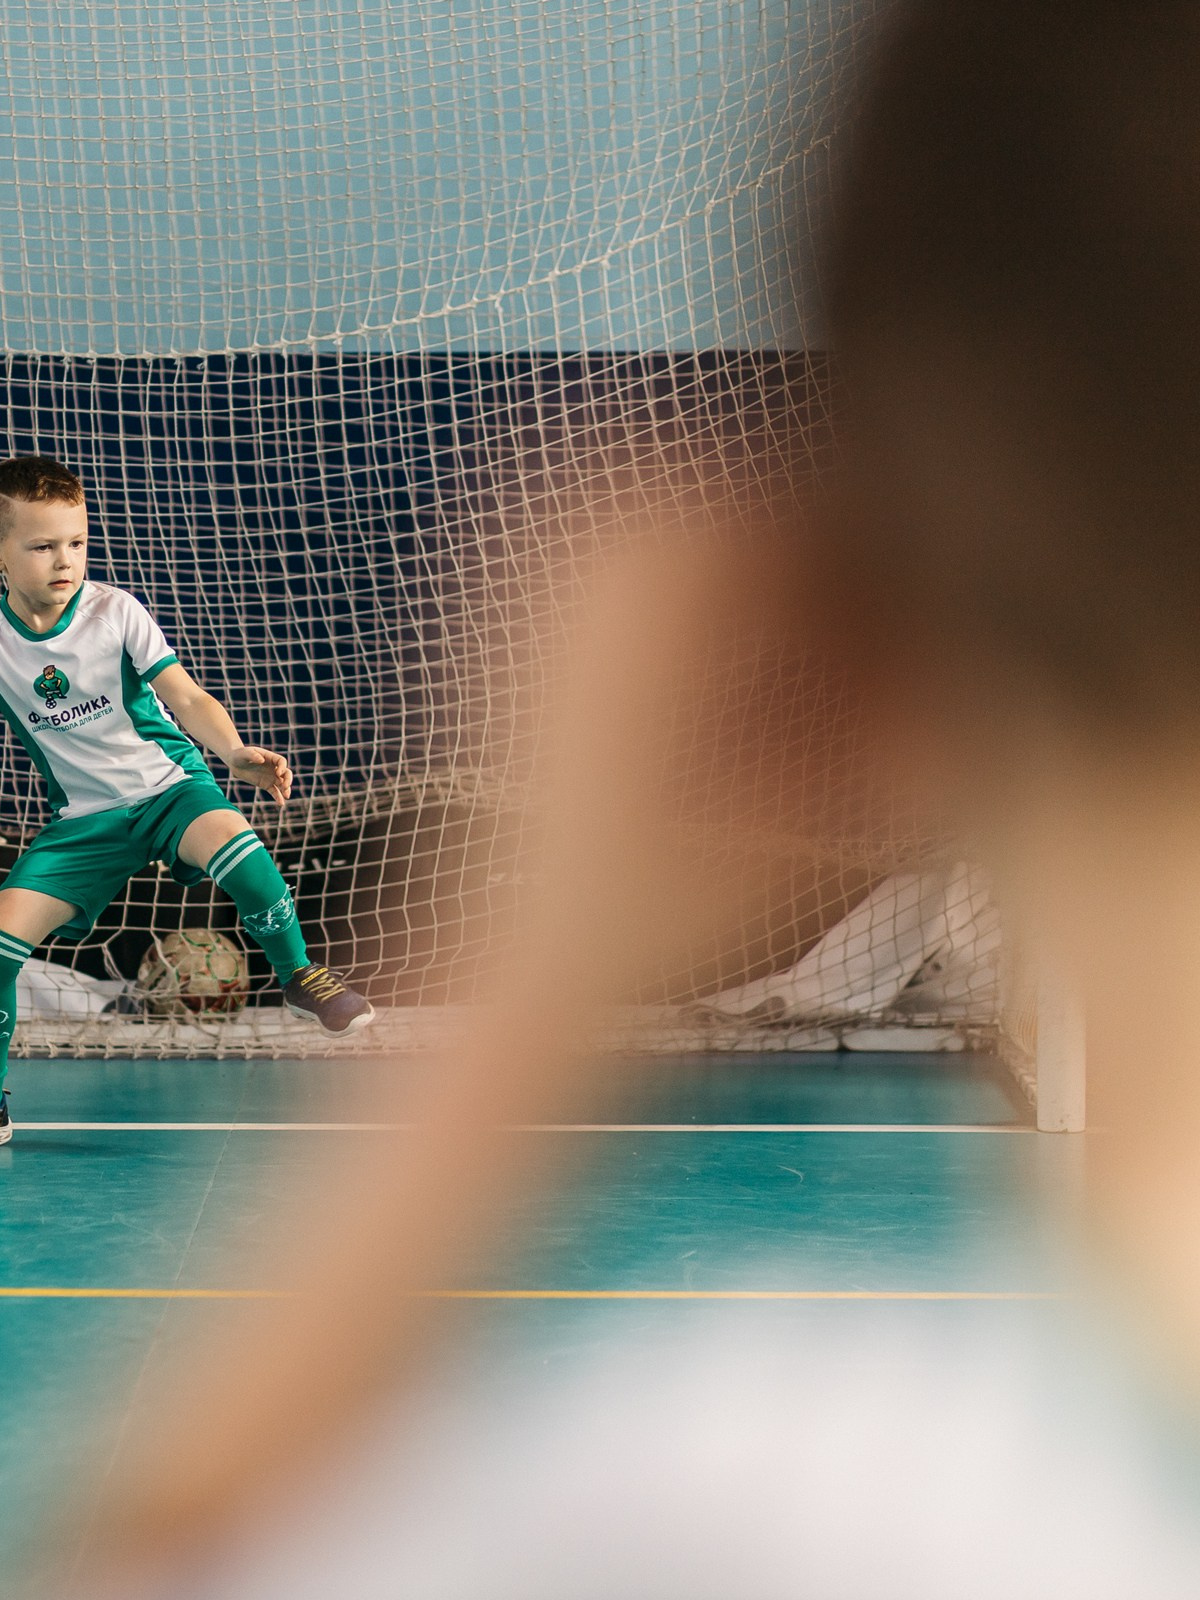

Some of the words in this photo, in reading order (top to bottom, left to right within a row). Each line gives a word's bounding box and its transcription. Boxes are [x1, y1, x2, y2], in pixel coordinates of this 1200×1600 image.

[28, 695, 111, 726] ФТБОЛИКА
[79, 716, 92, 726] ДЛЯ
[93, 706, 114, 720] ДЕТЕЙ
